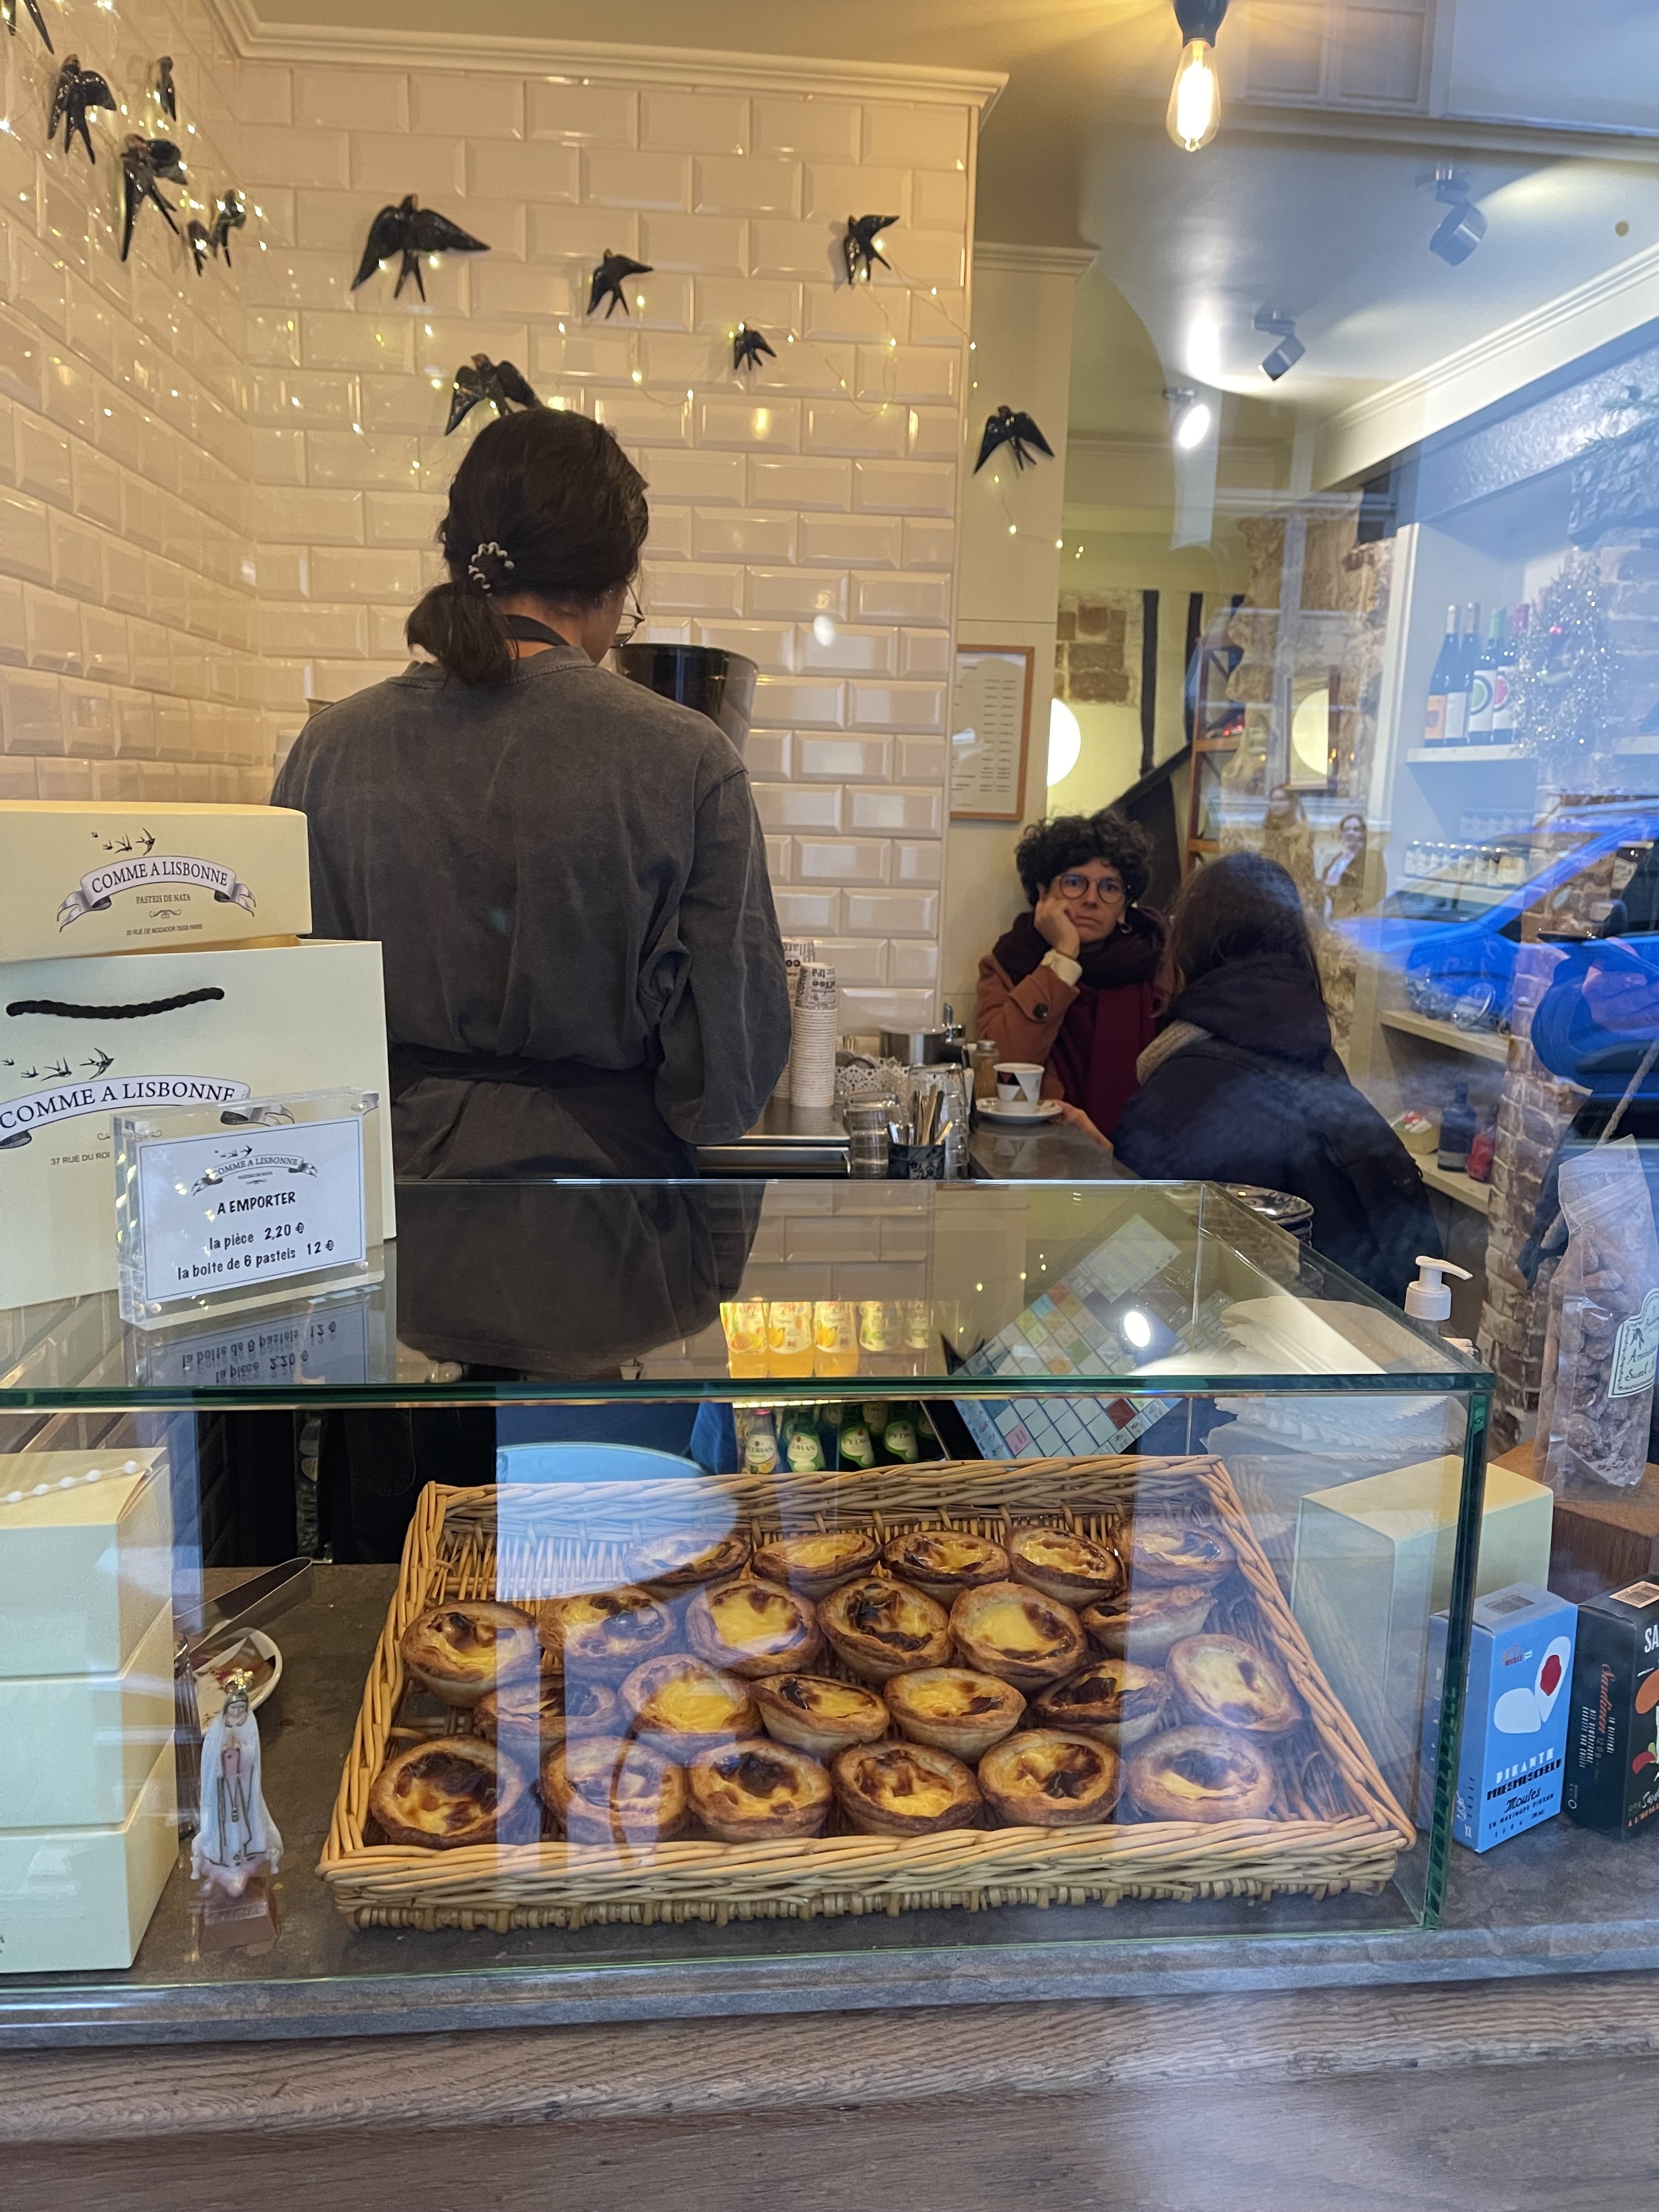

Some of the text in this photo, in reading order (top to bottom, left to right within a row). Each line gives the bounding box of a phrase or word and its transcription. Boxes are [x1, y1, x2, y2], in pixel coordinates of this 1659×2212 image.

[92, 861, 228, 893] COMME A LISBONNE
[0, 1082, 235, 1128] COMME A LISBONNE
[63, 1155, 80, 1164] RUE
[82, 1154, 94, 1162] DU
[215, 1159, 246, 1175] OMME
[255, 1157, 298, 1165] LISBONNE
[217, 1192, 295, 1215] A EMPORTER
[210, 1222, 304, 1250] la pièce 2,20 €
[178, 1267, 189, 1280] la
[227, 1258, 240, 1270] de
[244, 1255, 251, 1267] 6
[256, 1248, 295, 1268] pasteis
[307, 1242, 321, 1255] 12
[325, 1239, 334, 1251] €
[1504, 1787, 1541, 1813] Moules
